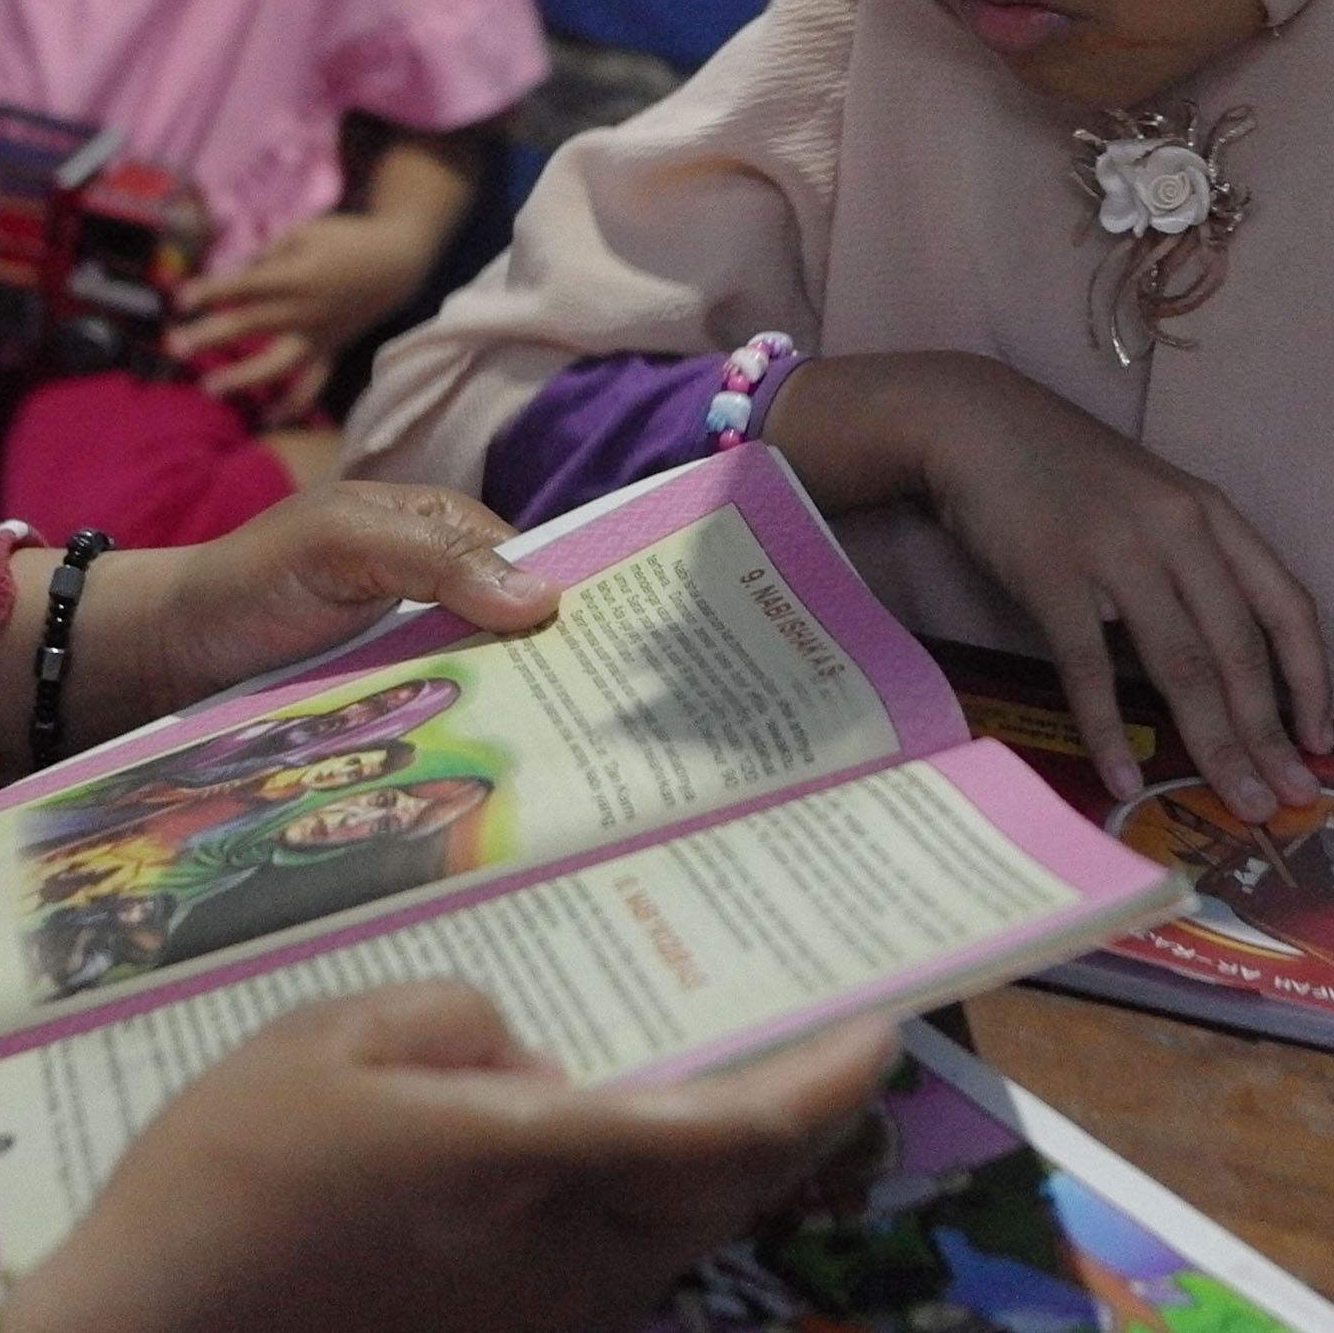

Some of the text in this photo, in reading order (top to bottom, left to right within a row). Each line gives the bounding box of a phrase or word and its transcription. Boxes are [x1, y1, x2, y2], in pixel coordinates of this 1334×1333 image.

[738, 567, 770, 589] 9.
[749, 583, 795, 623] NABI
[775, 616, 830, 658] ISHAK
